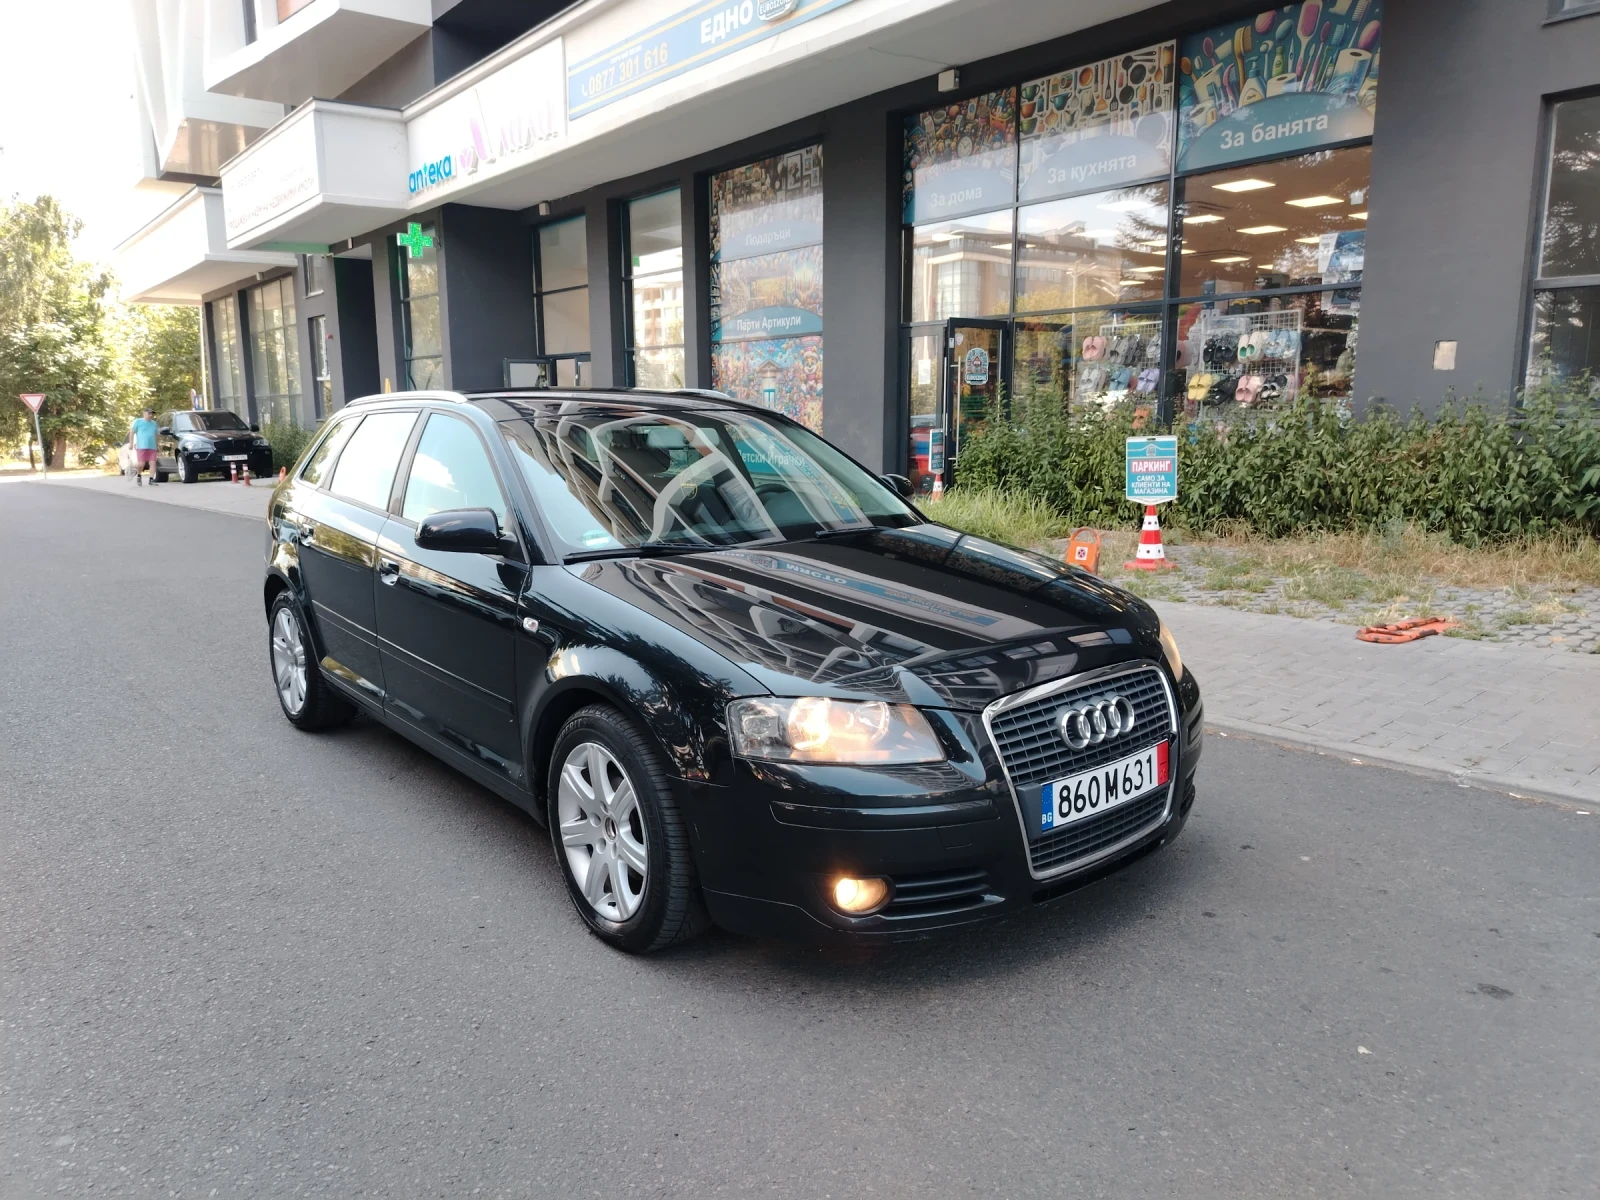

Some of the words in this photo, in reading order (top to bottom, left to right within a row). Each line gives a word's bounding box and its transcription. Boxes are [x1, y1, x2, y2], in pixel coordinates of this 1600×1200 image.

[700, 0, 753, 44] ЕДНО
[588, 66, 616, 95] 0877
[619, 56, 639, 82] 301
[644, 42, 668, 70] 616
[1220, 130, 1245, 149] За
[1251, 114, 1328, 143] банята
[1047, 168, 1066, 184] За
[1071, 155, 1137, 183] кухнята
[930, 193, 945, 208] За
[948, 186, 982, 207] дома
[746, 229, 791, 246] Подаръци
[737, 319, 760, 332] Парти
[762, 316, 801, 331] Артикули
[738, 450, 765, 464] етски
[1132, 461, 1171, 472] ПАРКИНГ
[1059, 754, 1152, 818] 860M631
[1041, 812, 1053, 825] BG
